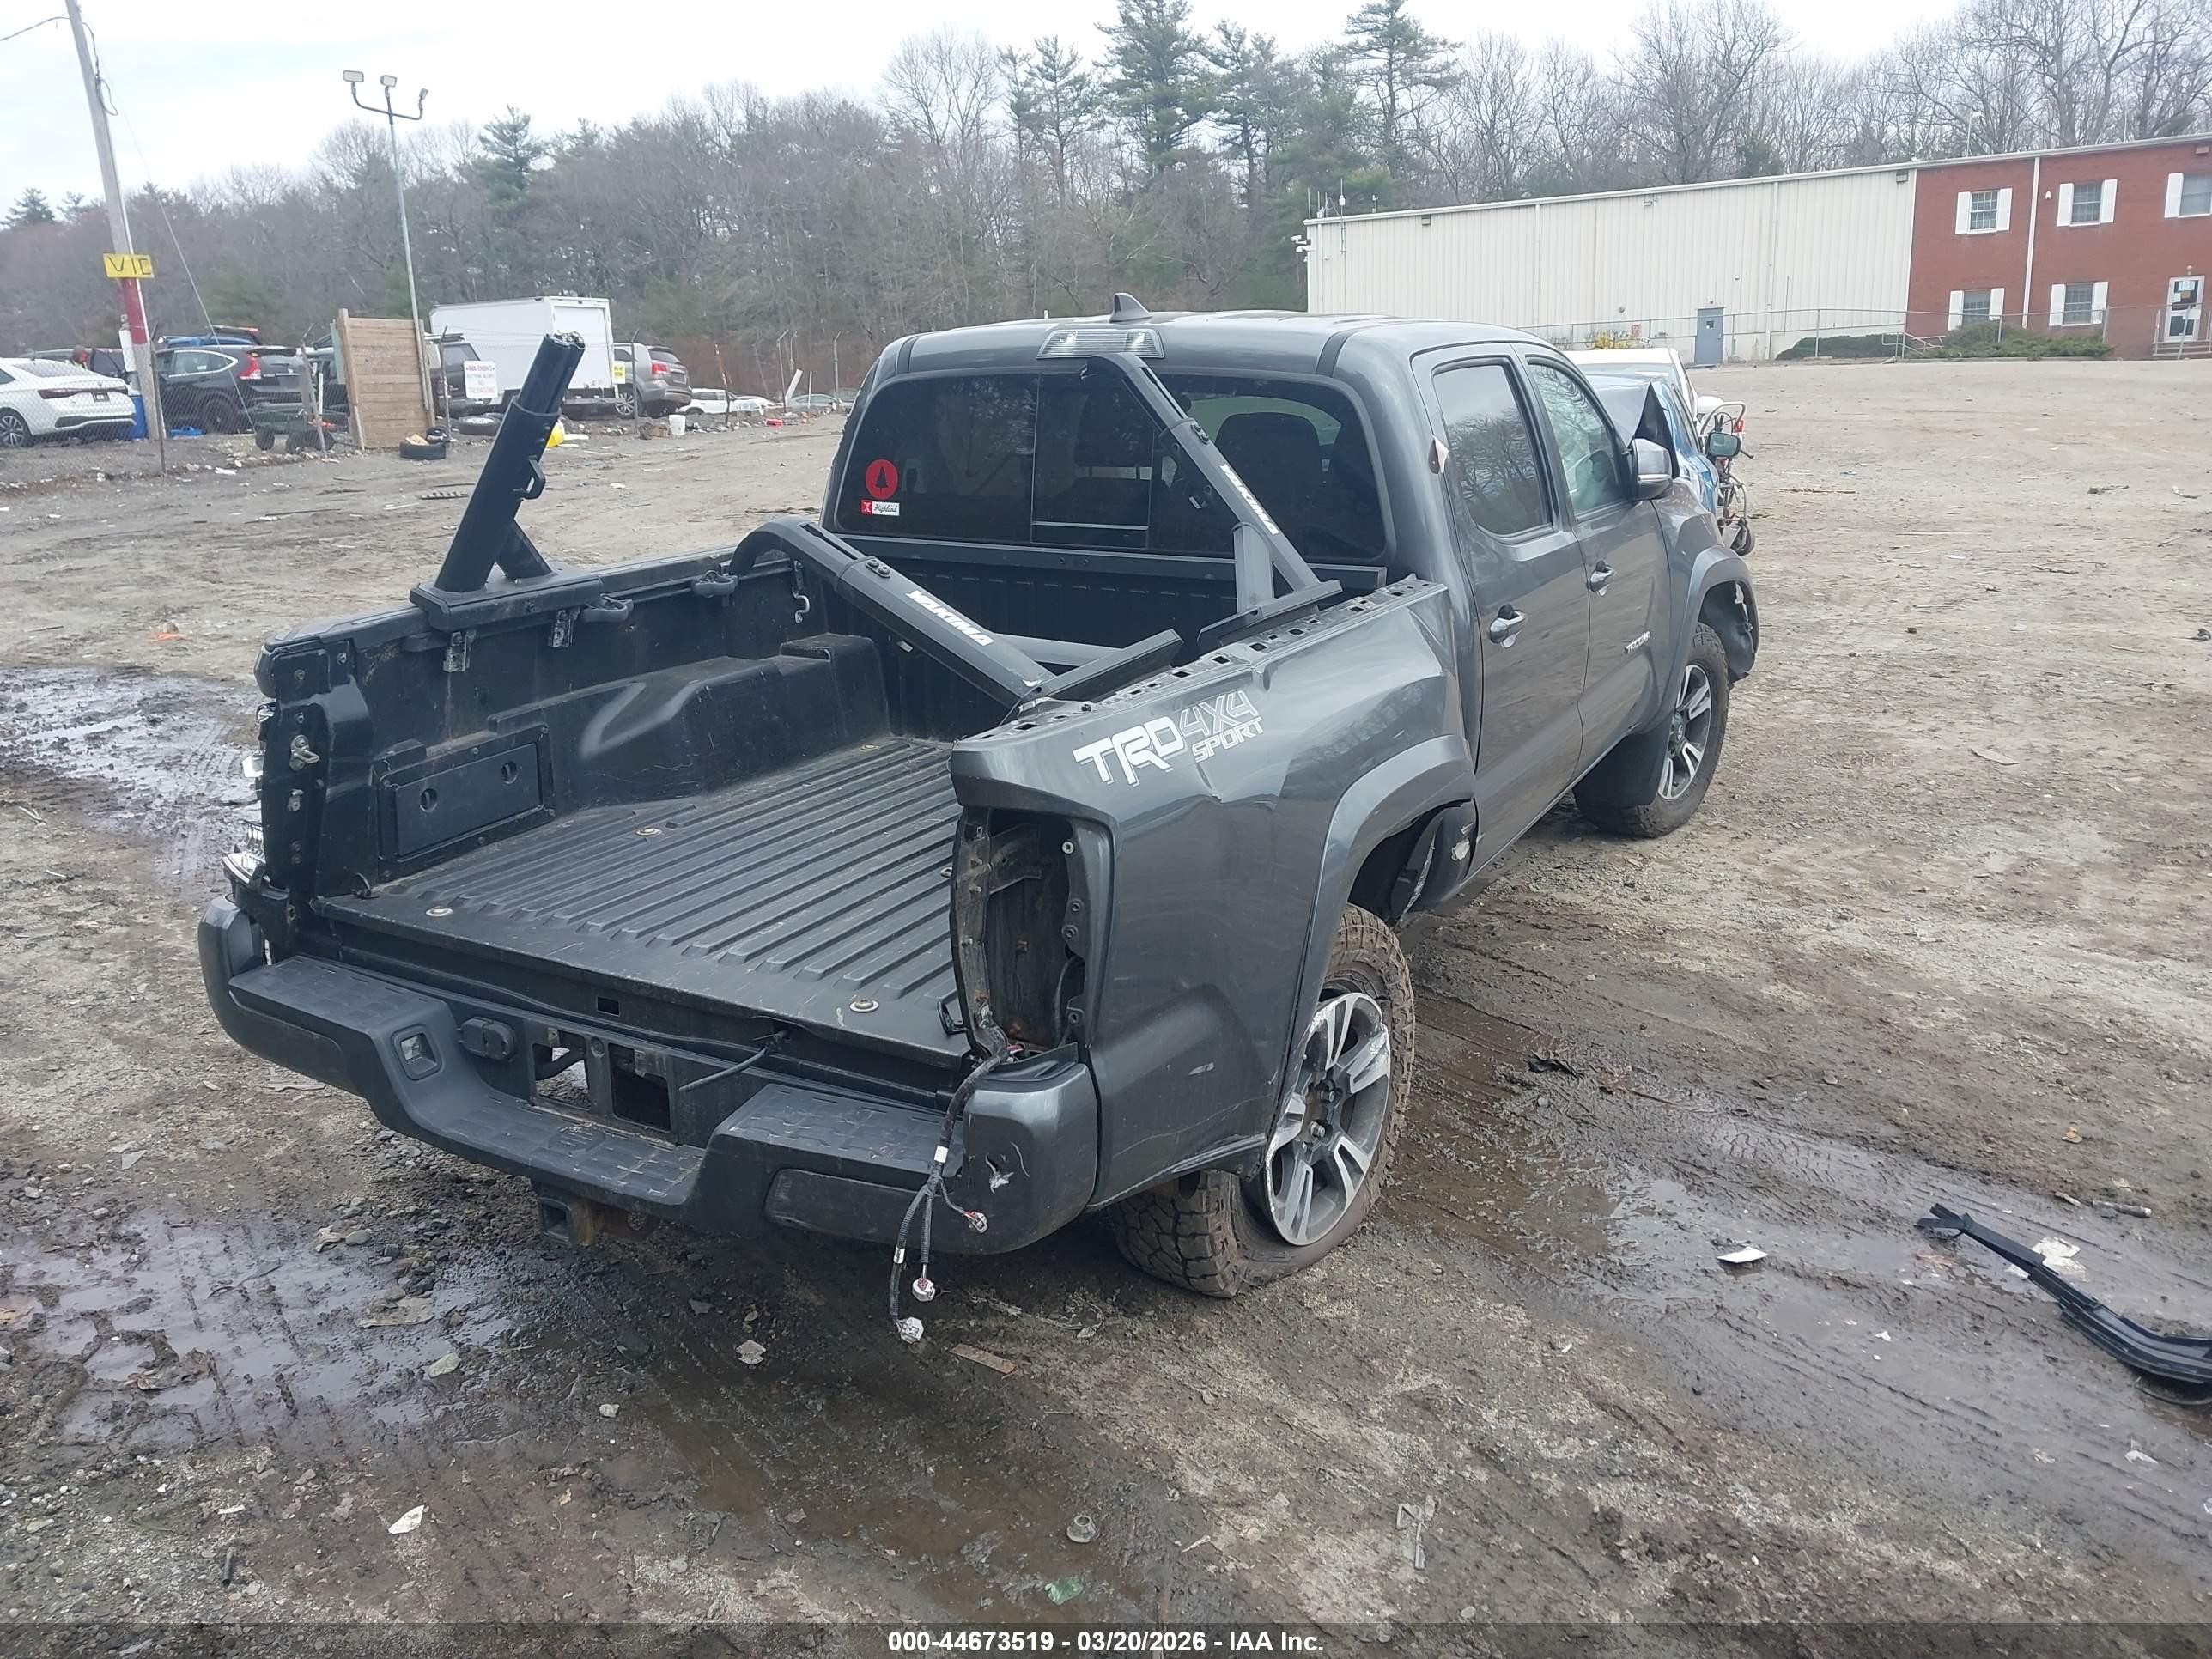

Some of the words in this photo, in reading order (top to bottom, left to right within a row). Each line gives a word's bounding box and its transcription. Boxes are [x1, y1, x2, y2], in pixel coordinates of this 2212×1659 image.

[1219, 463, 1279, 535] YAKIMA
[905, 590, 994, 646] YAKIMA
[1073, 716, 1187, 787] TRD
[1179, 690, 1259, 737] 4X4
[1191, 717, 1264, 763] SPORT
